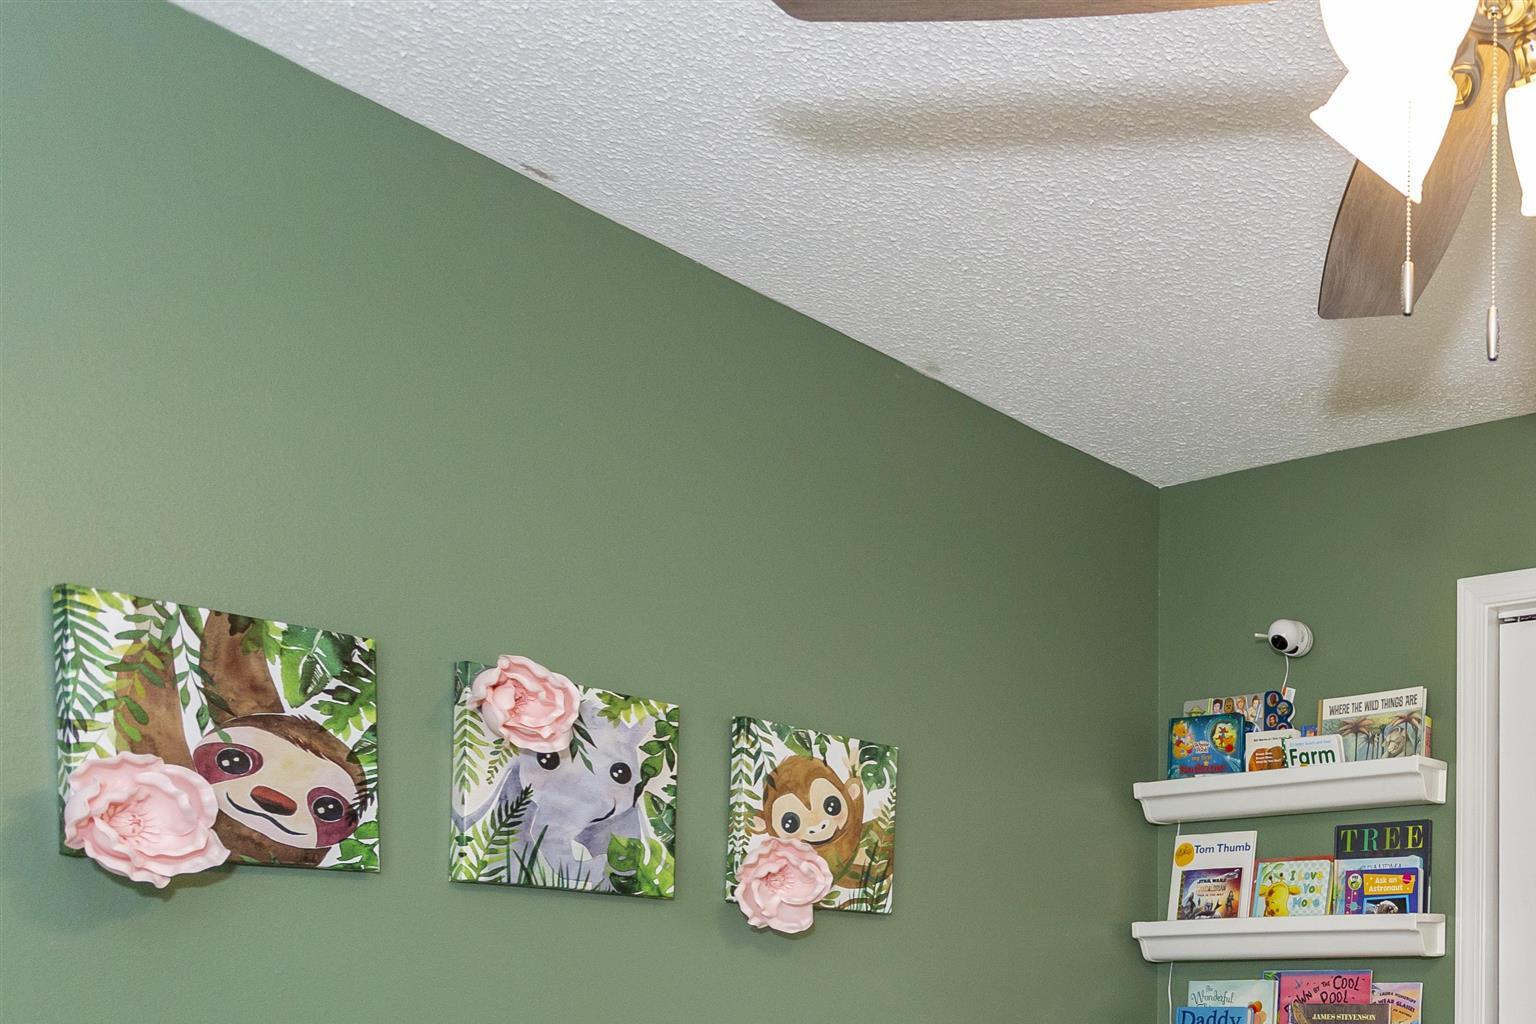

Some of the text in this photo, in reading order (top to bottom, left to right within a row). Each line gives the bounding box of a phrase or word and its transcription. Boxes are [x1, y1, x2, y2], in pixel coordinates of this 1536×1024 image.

[1329, 694, 1418, 716] WHERE THE WILD THINGS ARE
[1289, 747, 1336, 767] Farm
[1340, 825, 1424, 853] TREE
[1194, 844, 1215, 854] Tom
[1216, 842, 1251, 853] Thumb
[1332, 975, 1360, 991] COOL
[1190, 989, 1234, 1006] Wonderful
[1319, 989, 1349, 1004] POOL
[1312, 1013, 1376, 1021] JAMES STEVENSON
